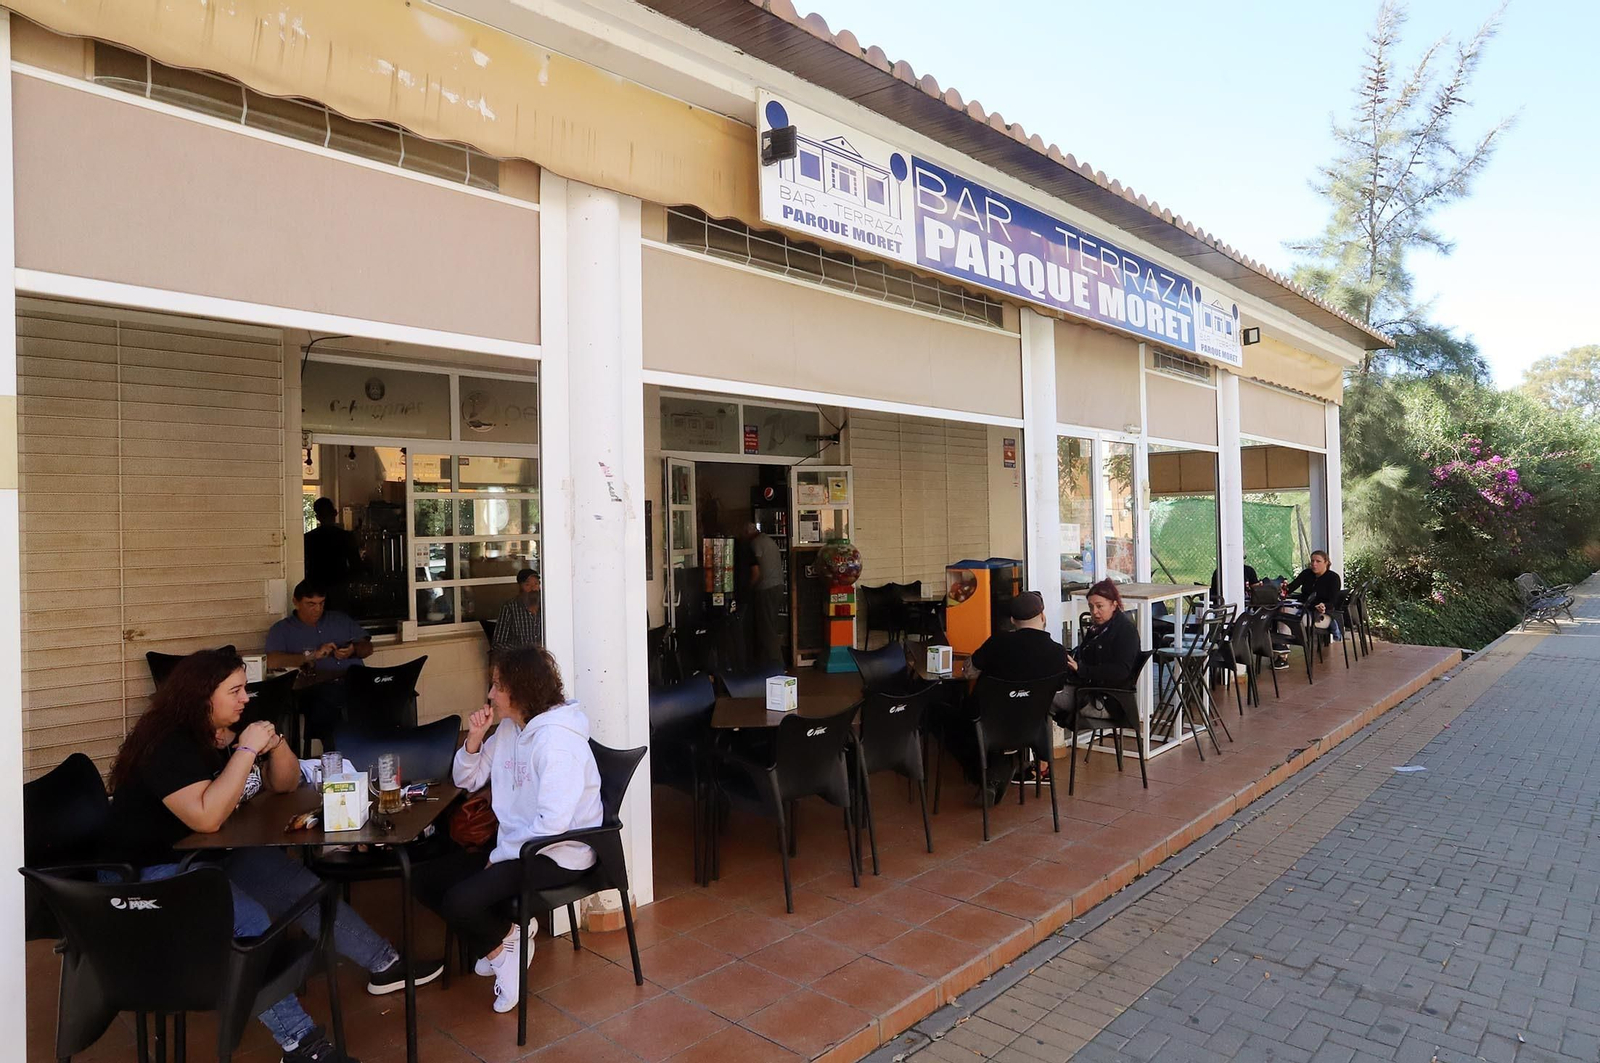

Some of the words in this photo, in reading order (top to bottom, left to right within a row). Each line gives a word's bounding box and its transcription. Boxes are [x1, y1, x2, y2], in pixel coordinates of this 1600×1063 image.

[779, 184, 816, 209] BAR
[833, 202, 904, 238] TERRAZA
[782, 204, 849, 237] PARQUE
[852, 226, 902, 254] MORET
[915, 166, 1012, 242] BAR
[1055, 226, 1194, 314] TERRAZA
[923, 216, 1091, 310] PARQUE
[1097, 281, 1191, 344] MORET
[1200, 343, 1222, 358] PARQUE
[1221, 350, 1239, 363] MORET
